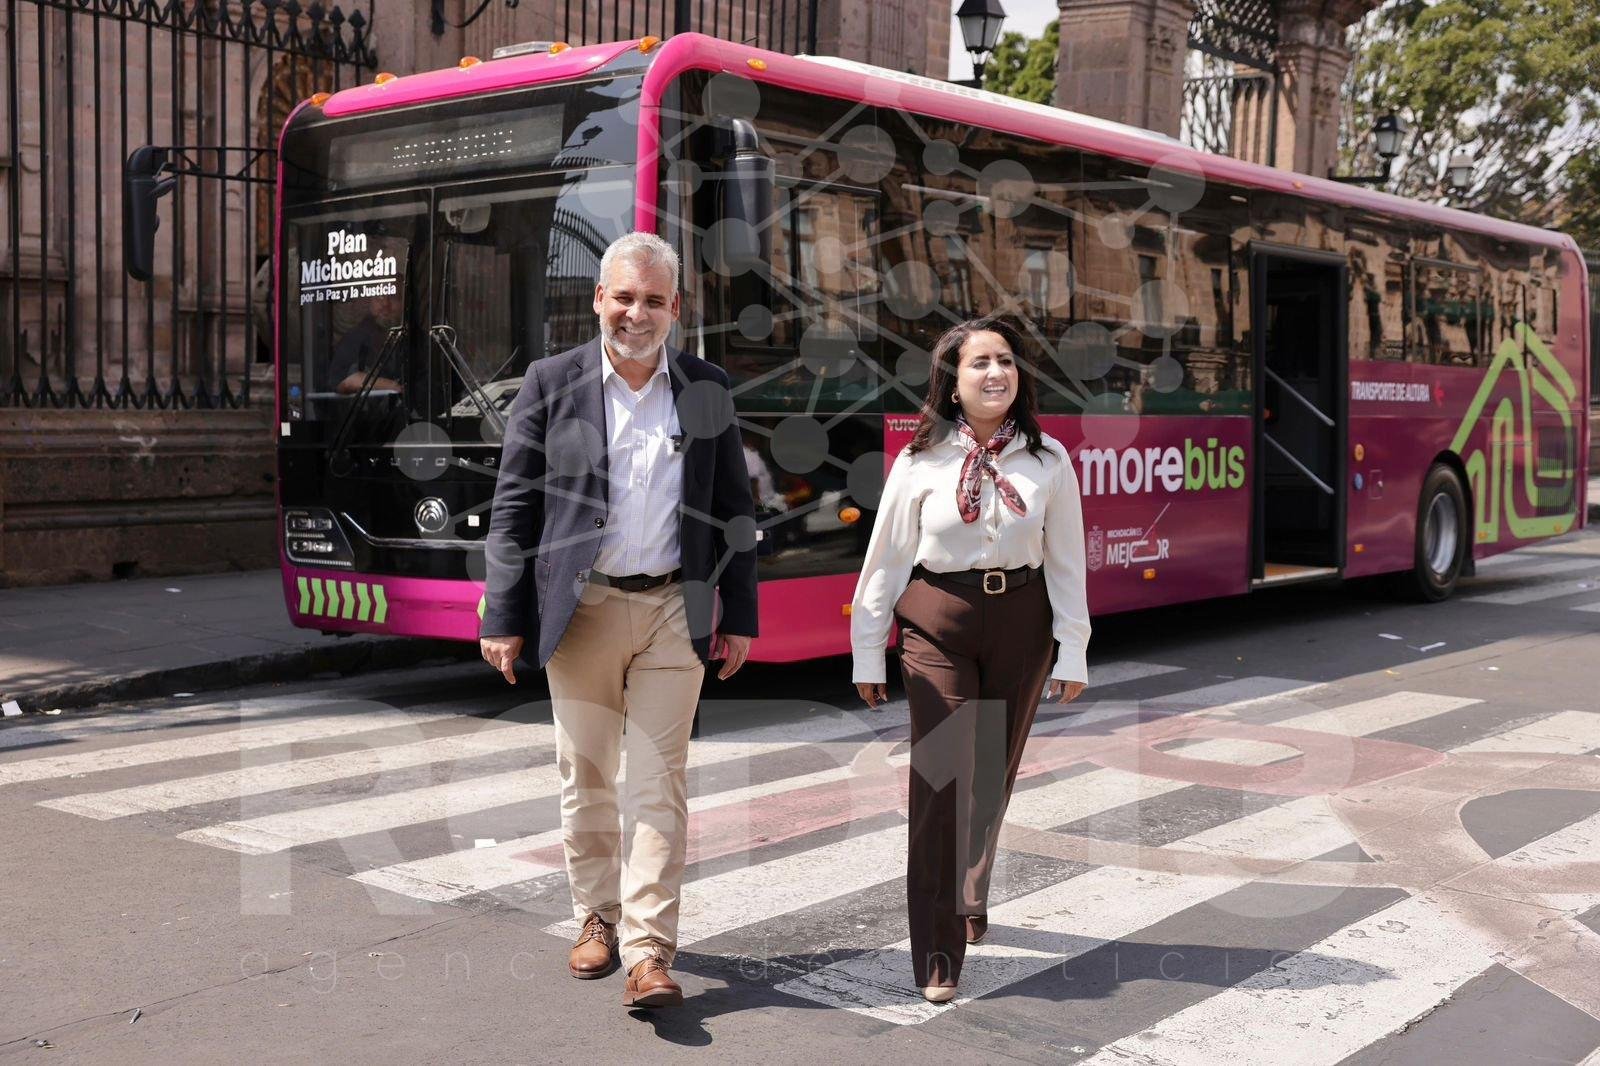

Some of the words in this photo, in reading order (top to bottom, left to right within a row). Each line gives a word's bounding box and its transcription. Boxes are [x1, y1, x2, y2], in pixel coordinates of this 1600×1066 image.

[327, 229, 367, 256] Plan
[300, 249, 397, 285] Michoacán
[300, 293, 314, 306] por
[316, 290, 324, 302] la
[326, 289, 341, 301] Paz
[342, 289, 349, 302] y
[350, 286, 359, 299] la
[360, 283, 397, 298] Justicia
[1351, 381, 1396, 401] TRANSPORTE
[1396, 382, 1405, 402] DE
[1406, 383, 1430, 402] ALTURA
[886, 418, 920, 432] YUTO
